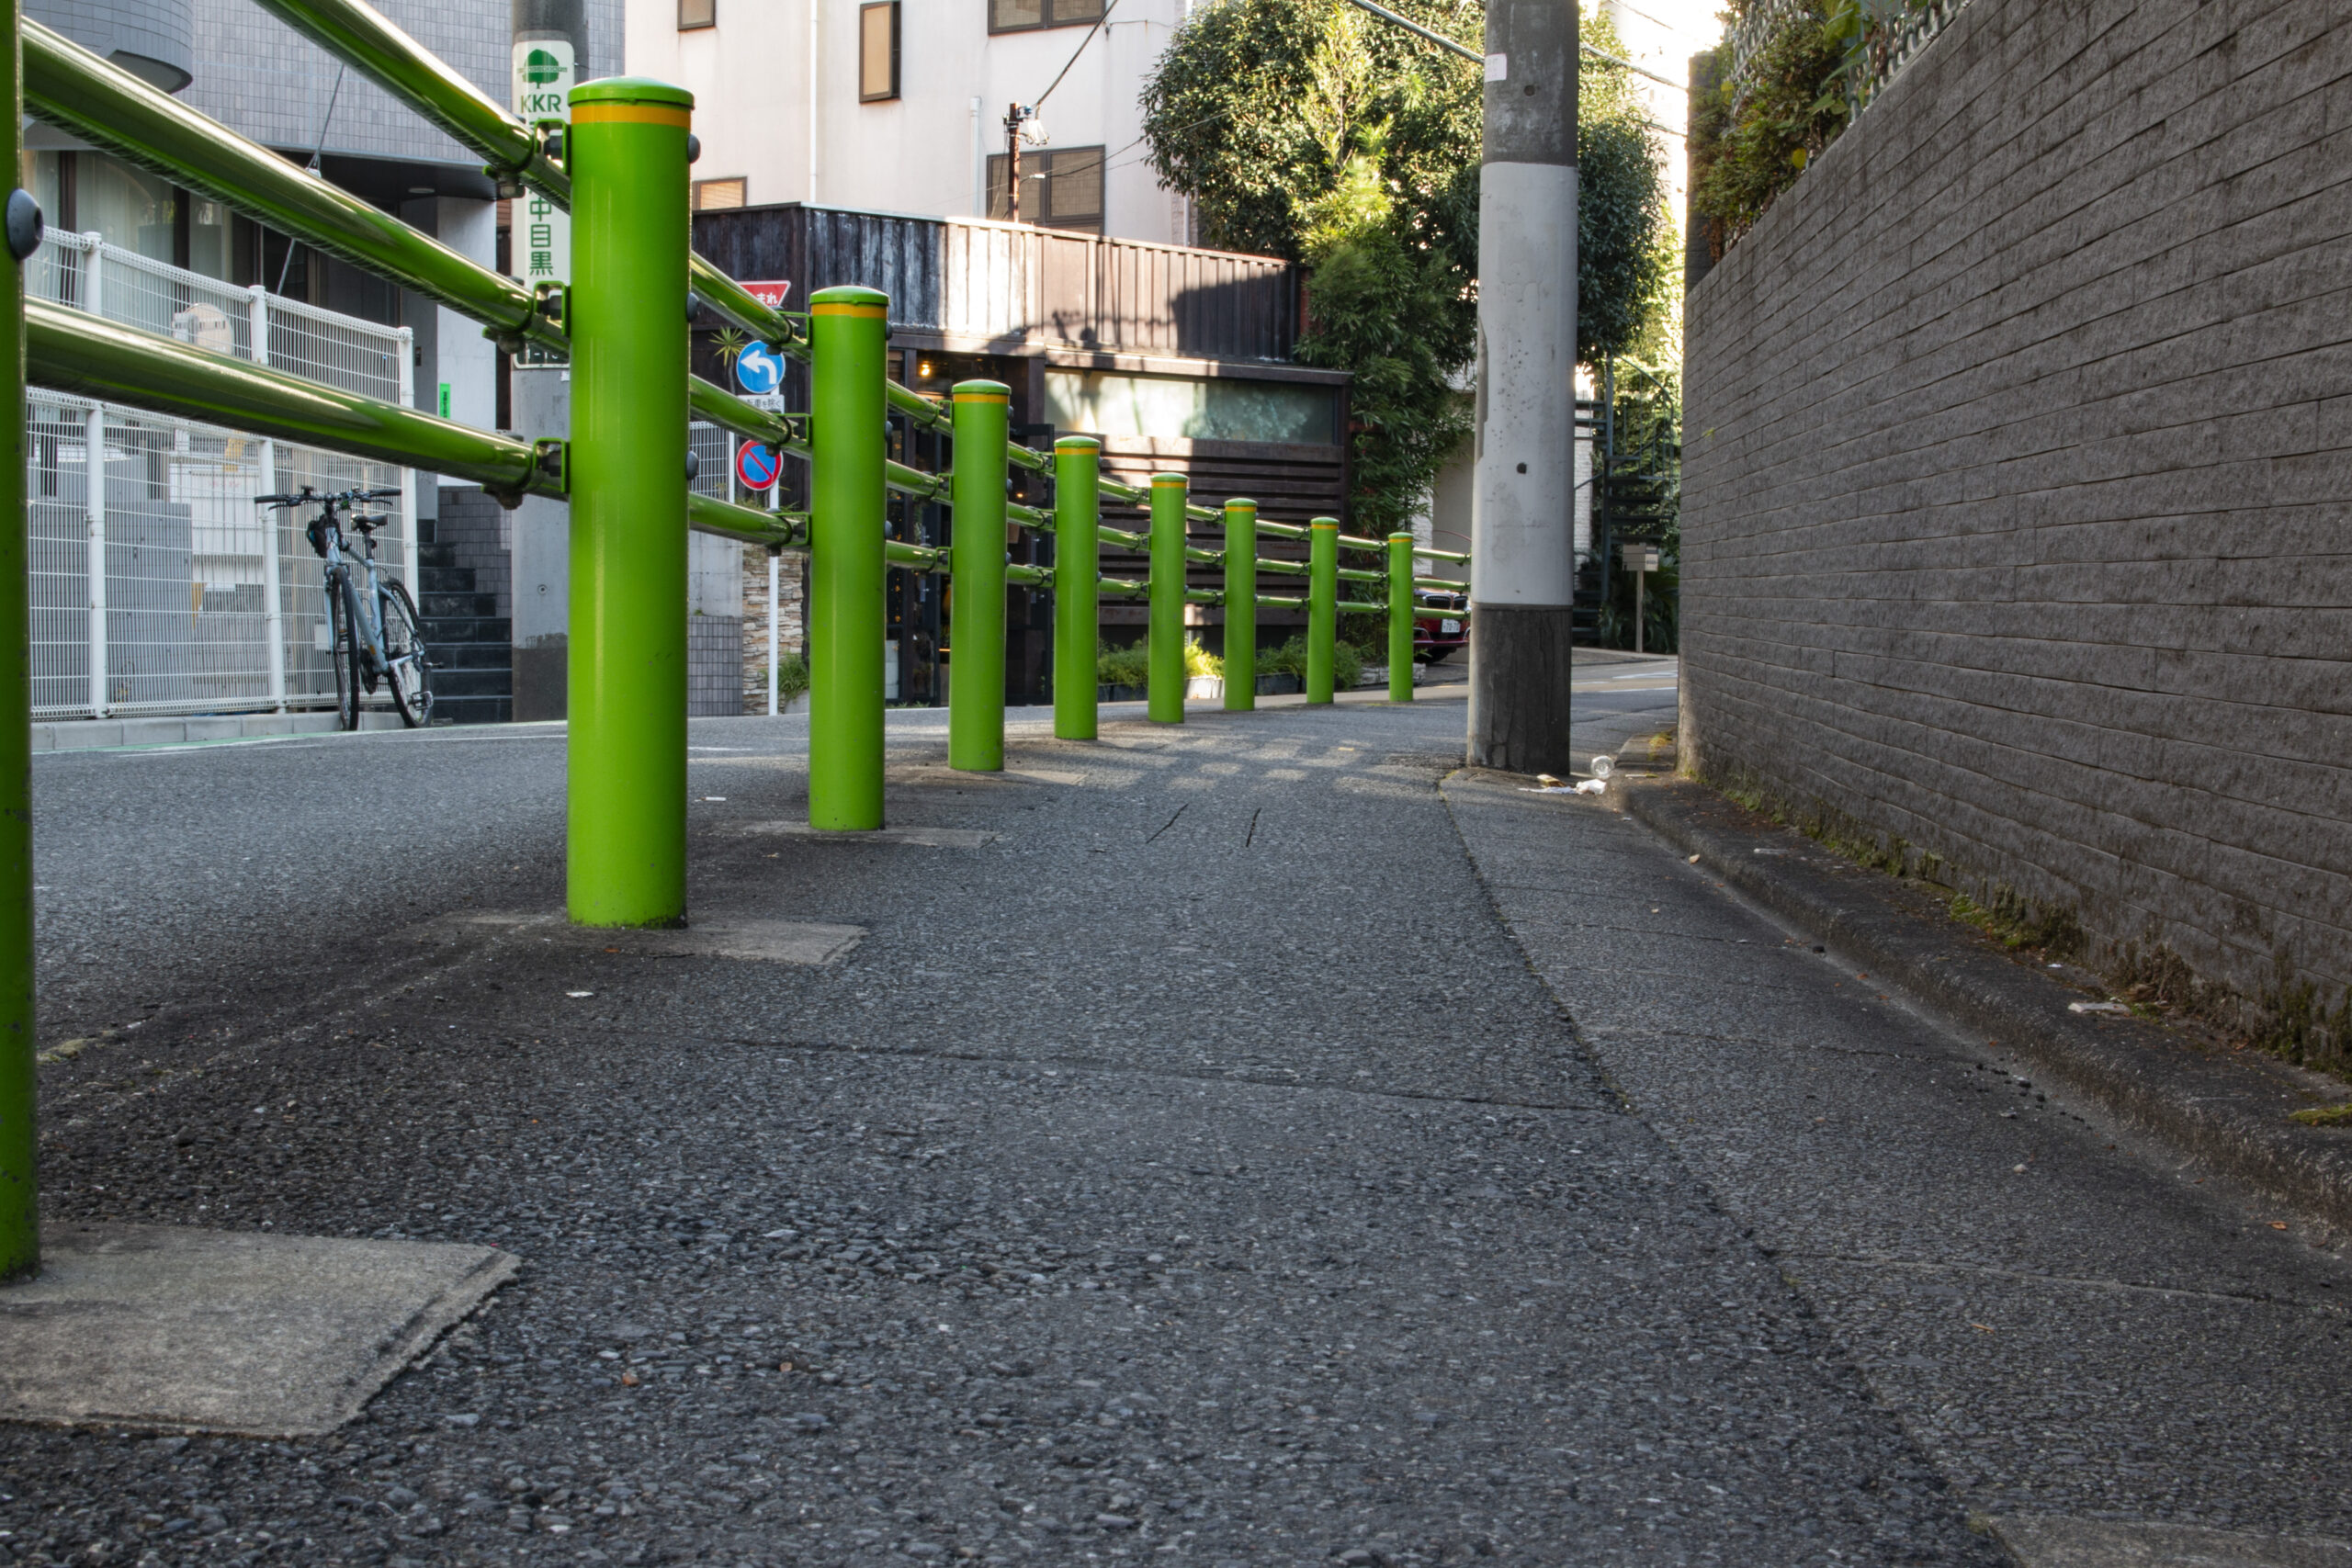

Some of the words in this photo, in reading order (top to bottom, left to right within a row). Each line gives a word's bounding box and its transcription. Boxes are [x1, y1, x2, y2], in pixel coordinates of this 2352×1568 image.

[521, 94, 561, 113] KKR
[529, 197, 553, 276] 中目黒
